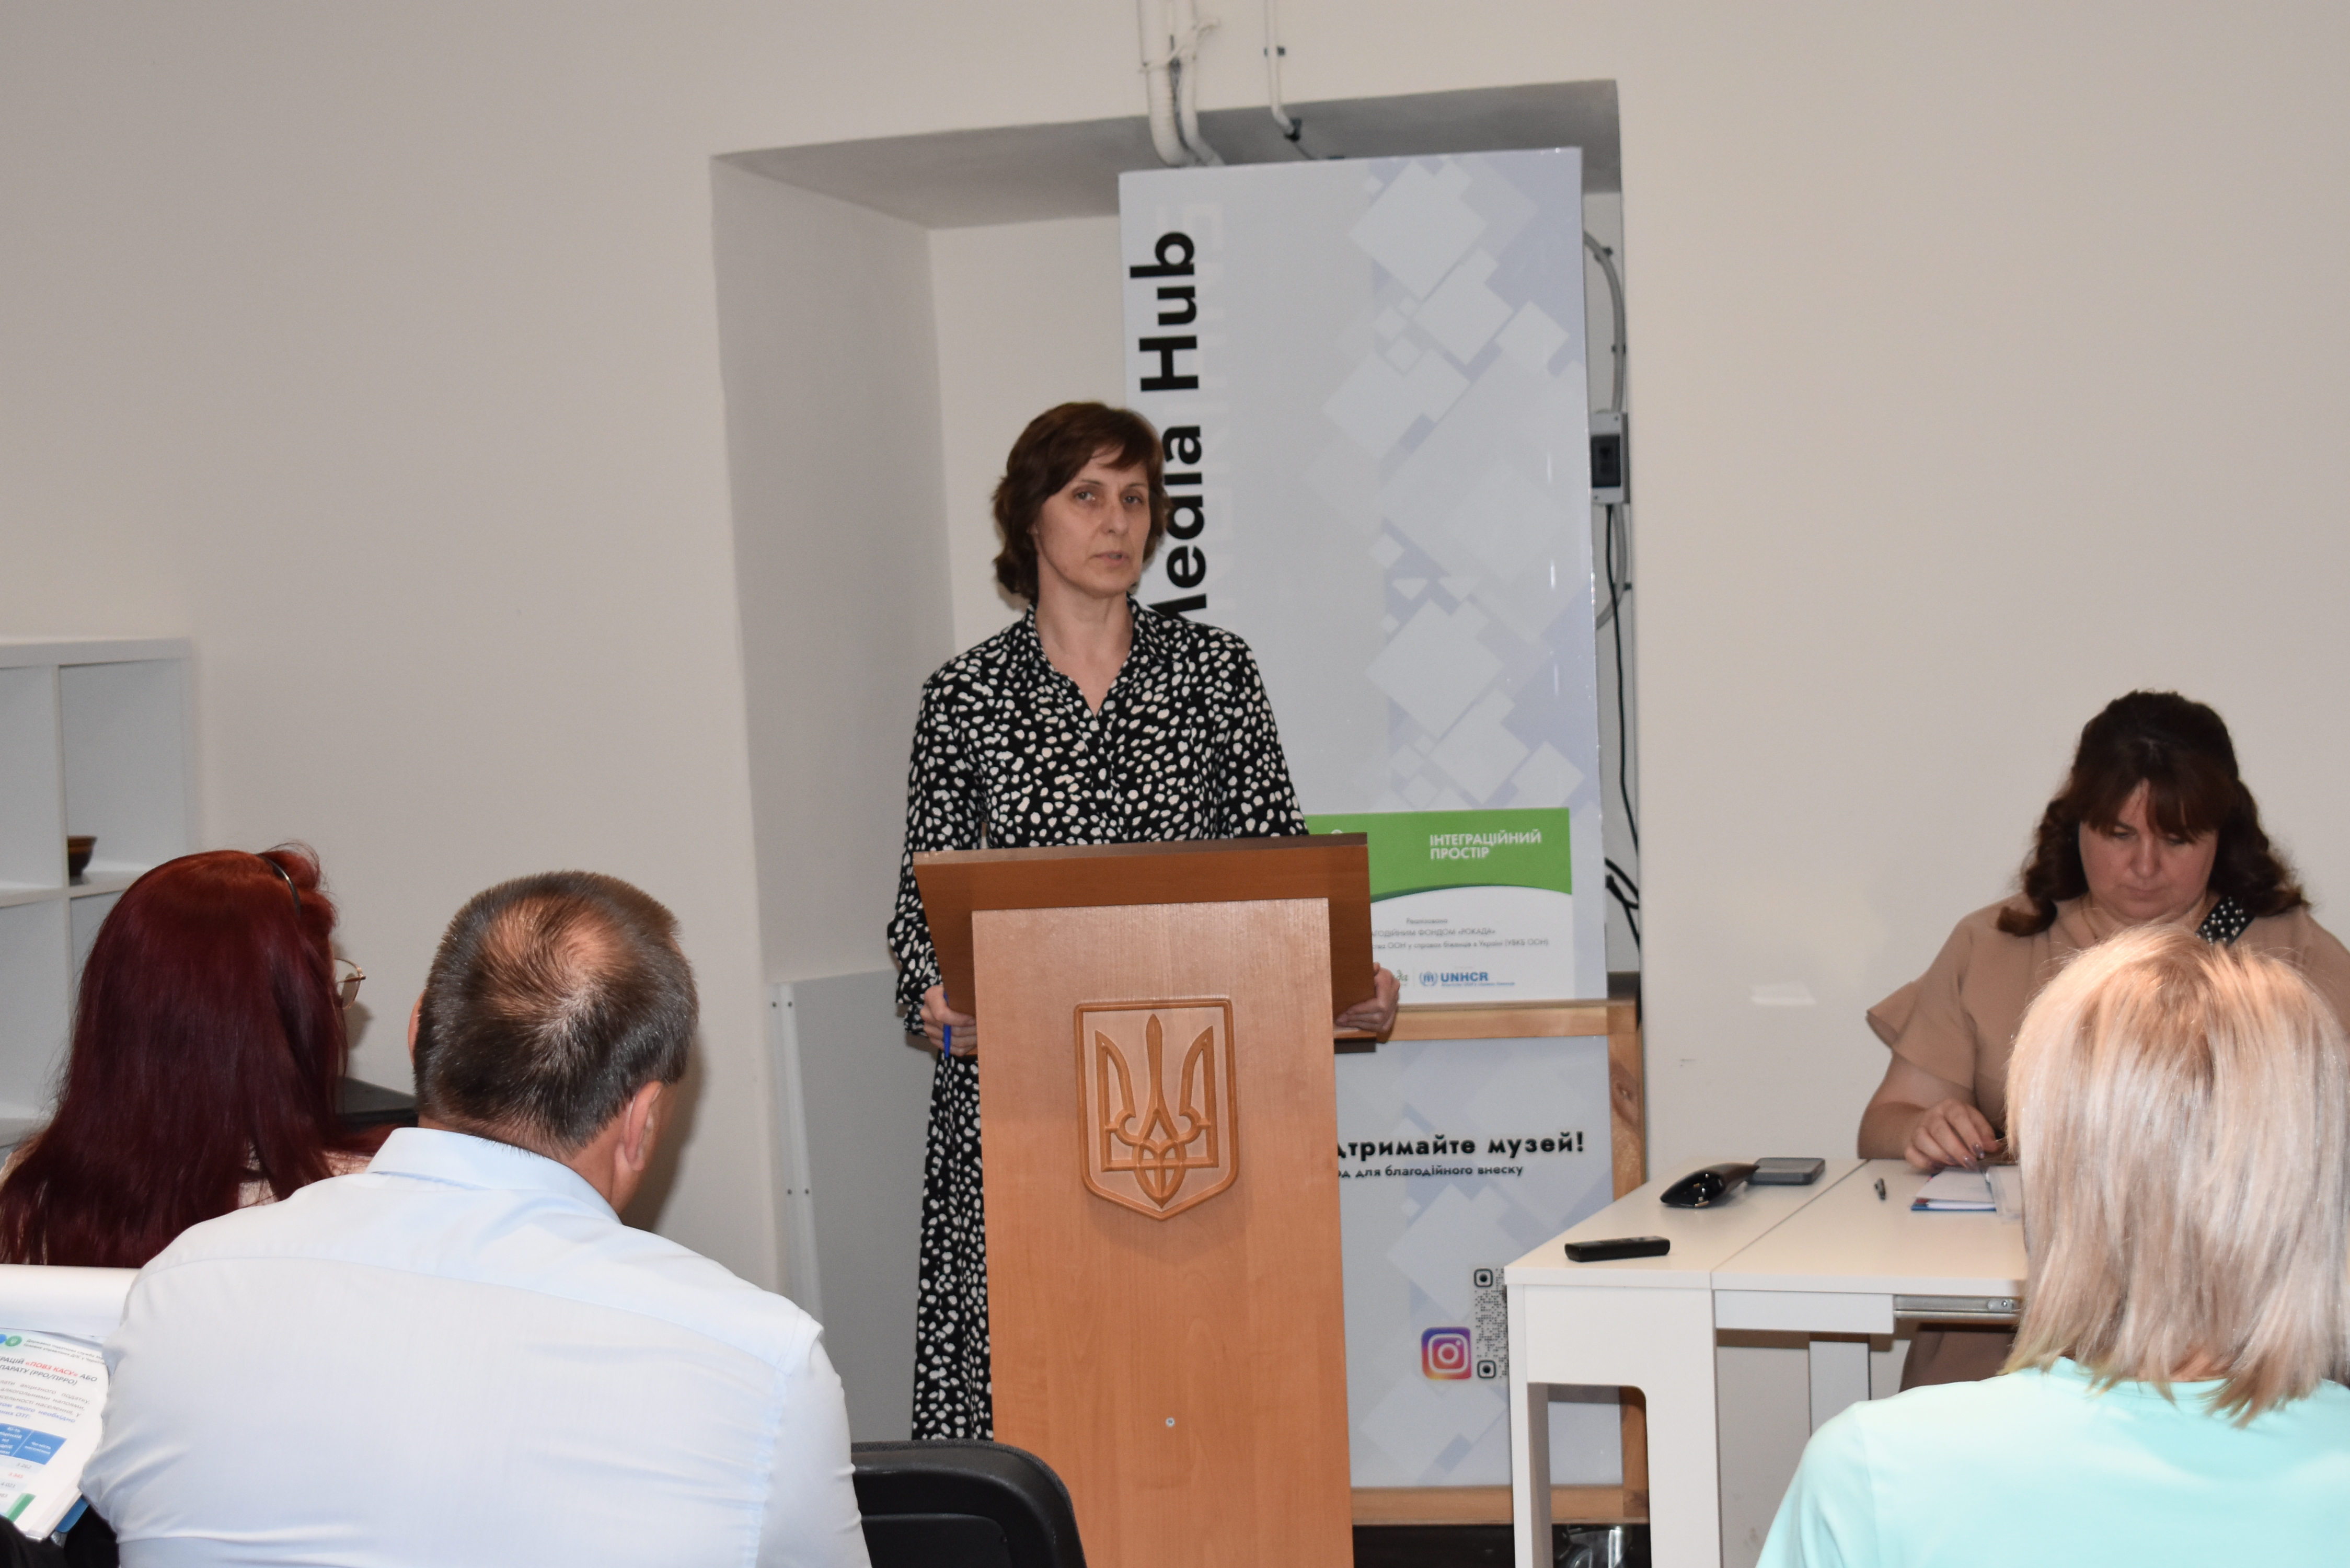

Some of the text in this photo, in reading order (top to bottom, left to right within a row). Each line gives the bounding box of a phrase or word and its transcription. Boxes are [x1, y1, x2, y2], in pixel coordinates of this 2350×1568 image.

[1130, 232, 1199, 392] Hub
[1430, 829, 1541, 846] ІНТЕГРАЦІЙНИЙ
[1430, 847, 1489, 859] ПРОСТІР
[1441, 972, 1489, 982] UNHCR
[1488, 1131, 1584, 1159] музей!
[1355, 1169, 1380, 1178] для
[1385, 1165, 1473, 1176] благодійного
[1478, 1166, 1523, 1177] внеску
[29, 1369, 78, 1385] (РРО/ПРРО)
[79, 1374, 98, 1382] АБО
[20, 1383, 56, 1394] акцизного
[1, 1387, 85, 1411] алкогольними напоями,
[38, 1410, 76, 1423] необхідно
